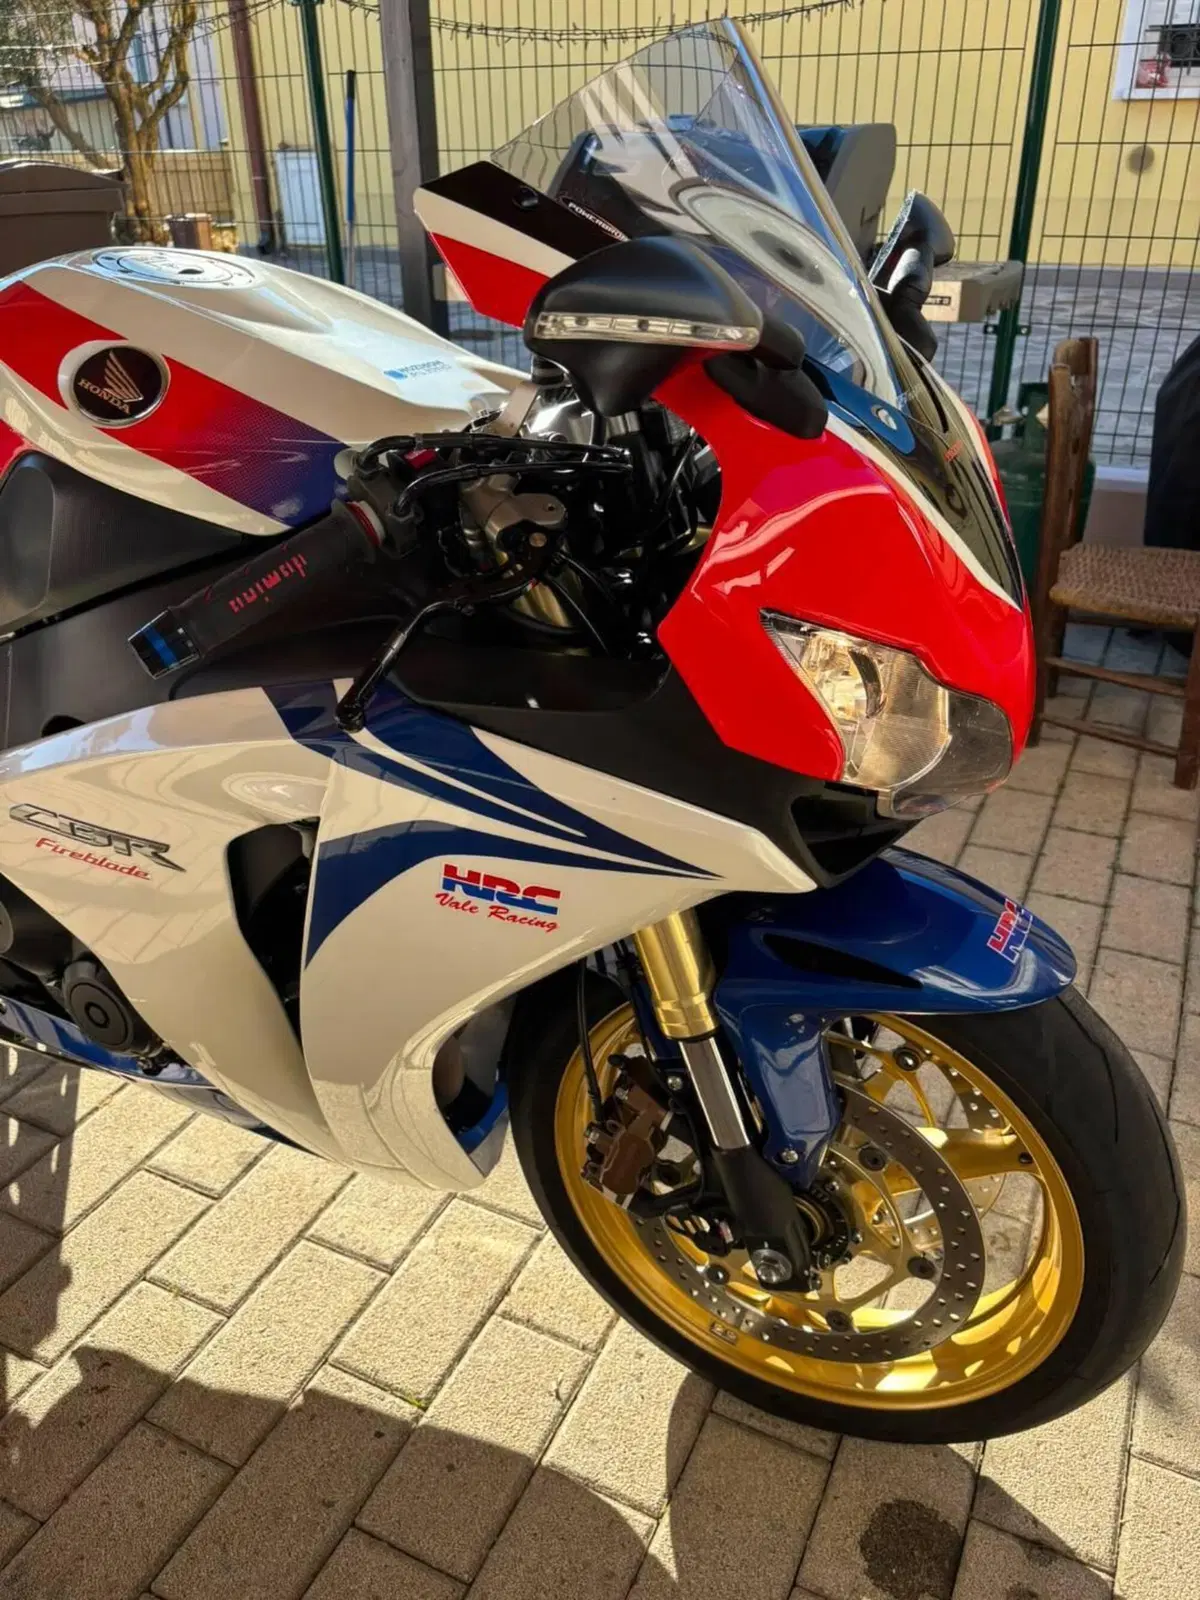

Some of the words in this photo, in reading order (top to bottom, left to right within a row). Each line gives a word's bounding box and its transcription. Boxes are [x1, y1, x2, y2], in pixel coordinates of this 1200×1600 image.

[78, 378, 131, 414] HONDA
[9, 803, 187, 873] CBR
[35, 837, 151, 881] Fireblade
[441, 863, 562, 916] HRC
[434, 891, 480, 915] Vale
[486, 904, 559, 933] Racing
